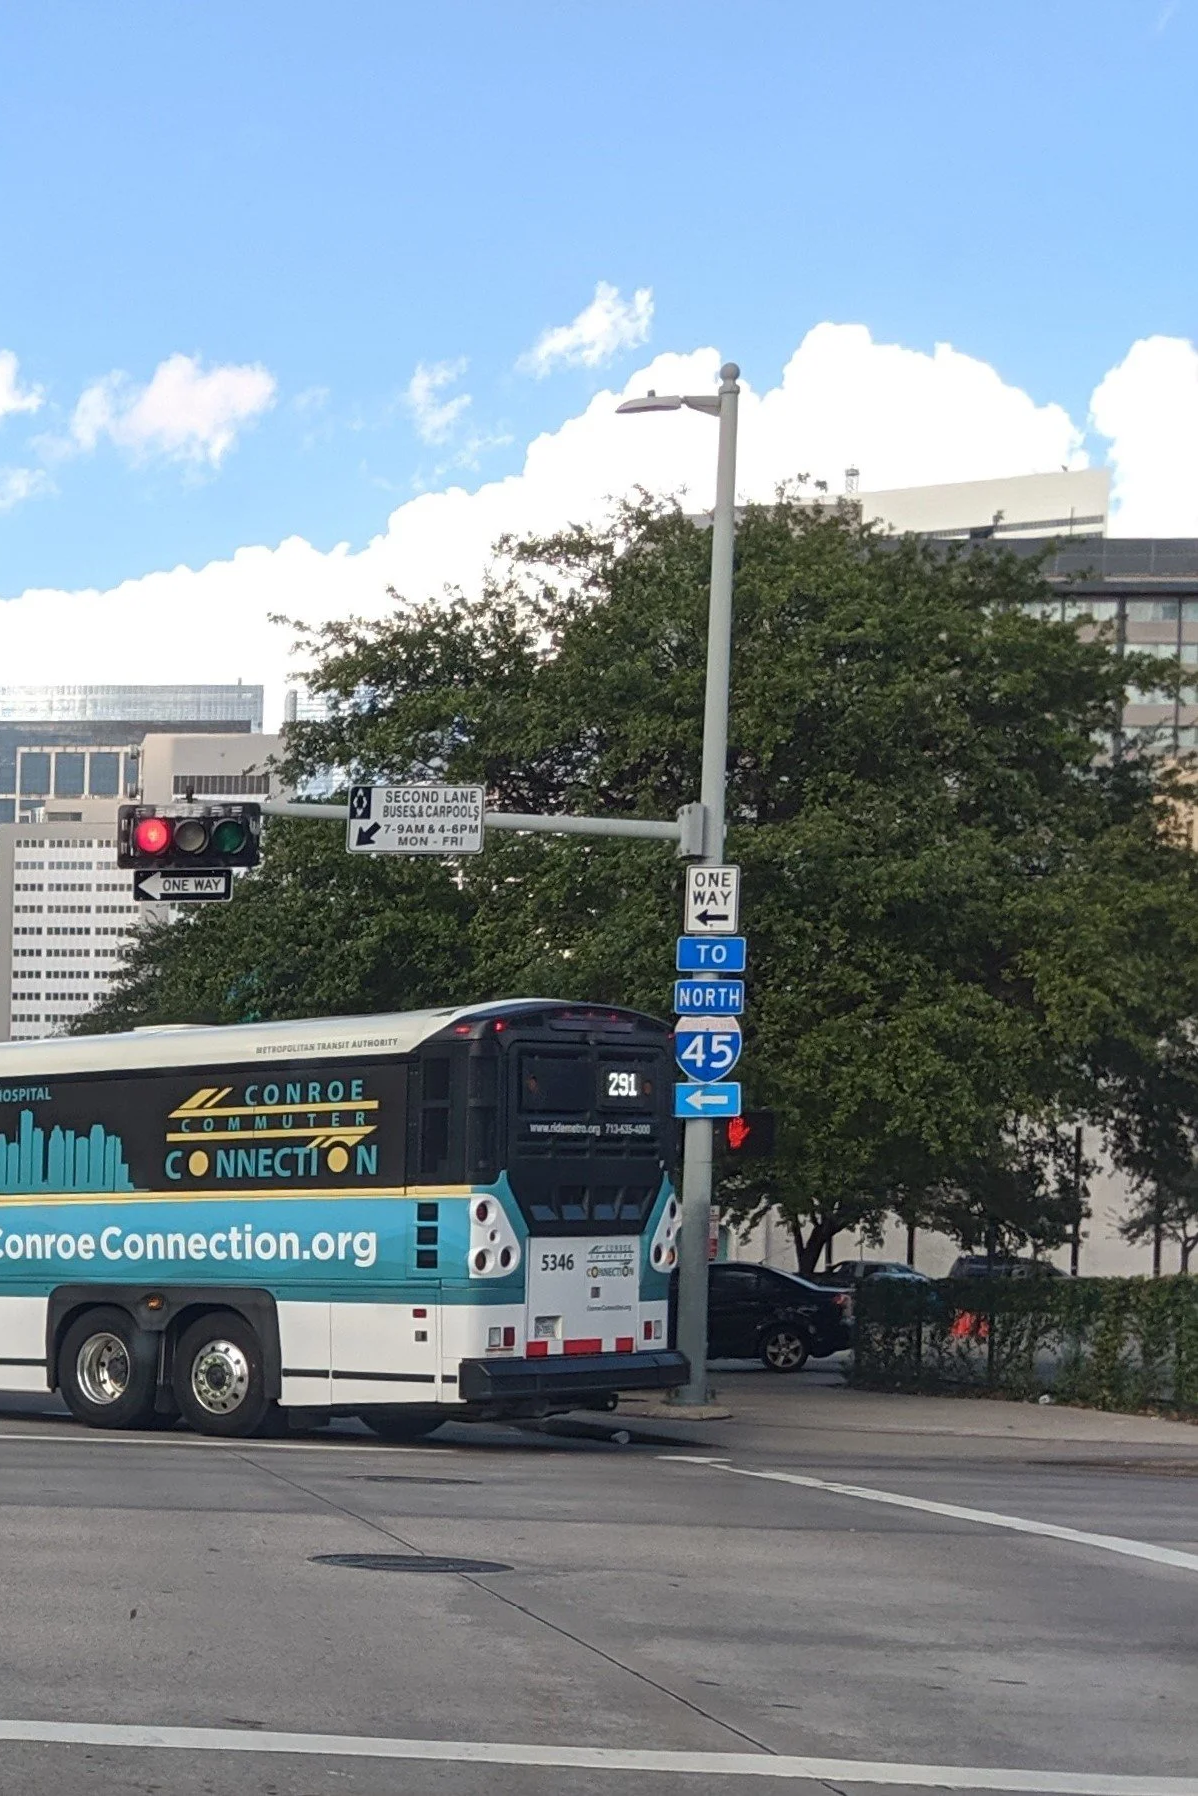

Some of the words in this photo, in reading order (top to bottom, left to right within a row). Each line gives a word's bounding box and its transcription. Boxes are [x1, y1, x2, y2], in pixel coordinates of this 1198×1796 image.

[385, 790, 439, 803] SECOND
[444, 790, 477, 803] LANE
[425, 805, 480, 818] CARPOOLS
[384, 824, 424, 834] 7-9AM
[427, 824, 435, 834] &
[438, 824, 479, 834] 4-6PM
[398, 836, 429, 846] MON
[442, 836, 463, 846] FRI
[162, 879, 189, 892] ONE
[194, 878, 222, 891] WAY
[694, 872, 732, 888] ONE
[692, 890, 733, 906] WAY
[696, 944, 727, 964] TO
[679, 987, 740, 1007] NORTH
[256, 1043, 315, 1054] METROPOLITAN
[317, 1040, 350, 1051] TRANSIT
[351, 1037, 399, 1048] AUTHORITY
[681, 1034, 733, 1069] 45
[244, 1079, 364, 1106] CONROE
[608, 1072, 638, 1096] 291
[180, 1111, 366, 1133] COMMUTER
[164, 1144, 379, 1180] CONNECTION
[540, 1253, 575, 1271] 5346
